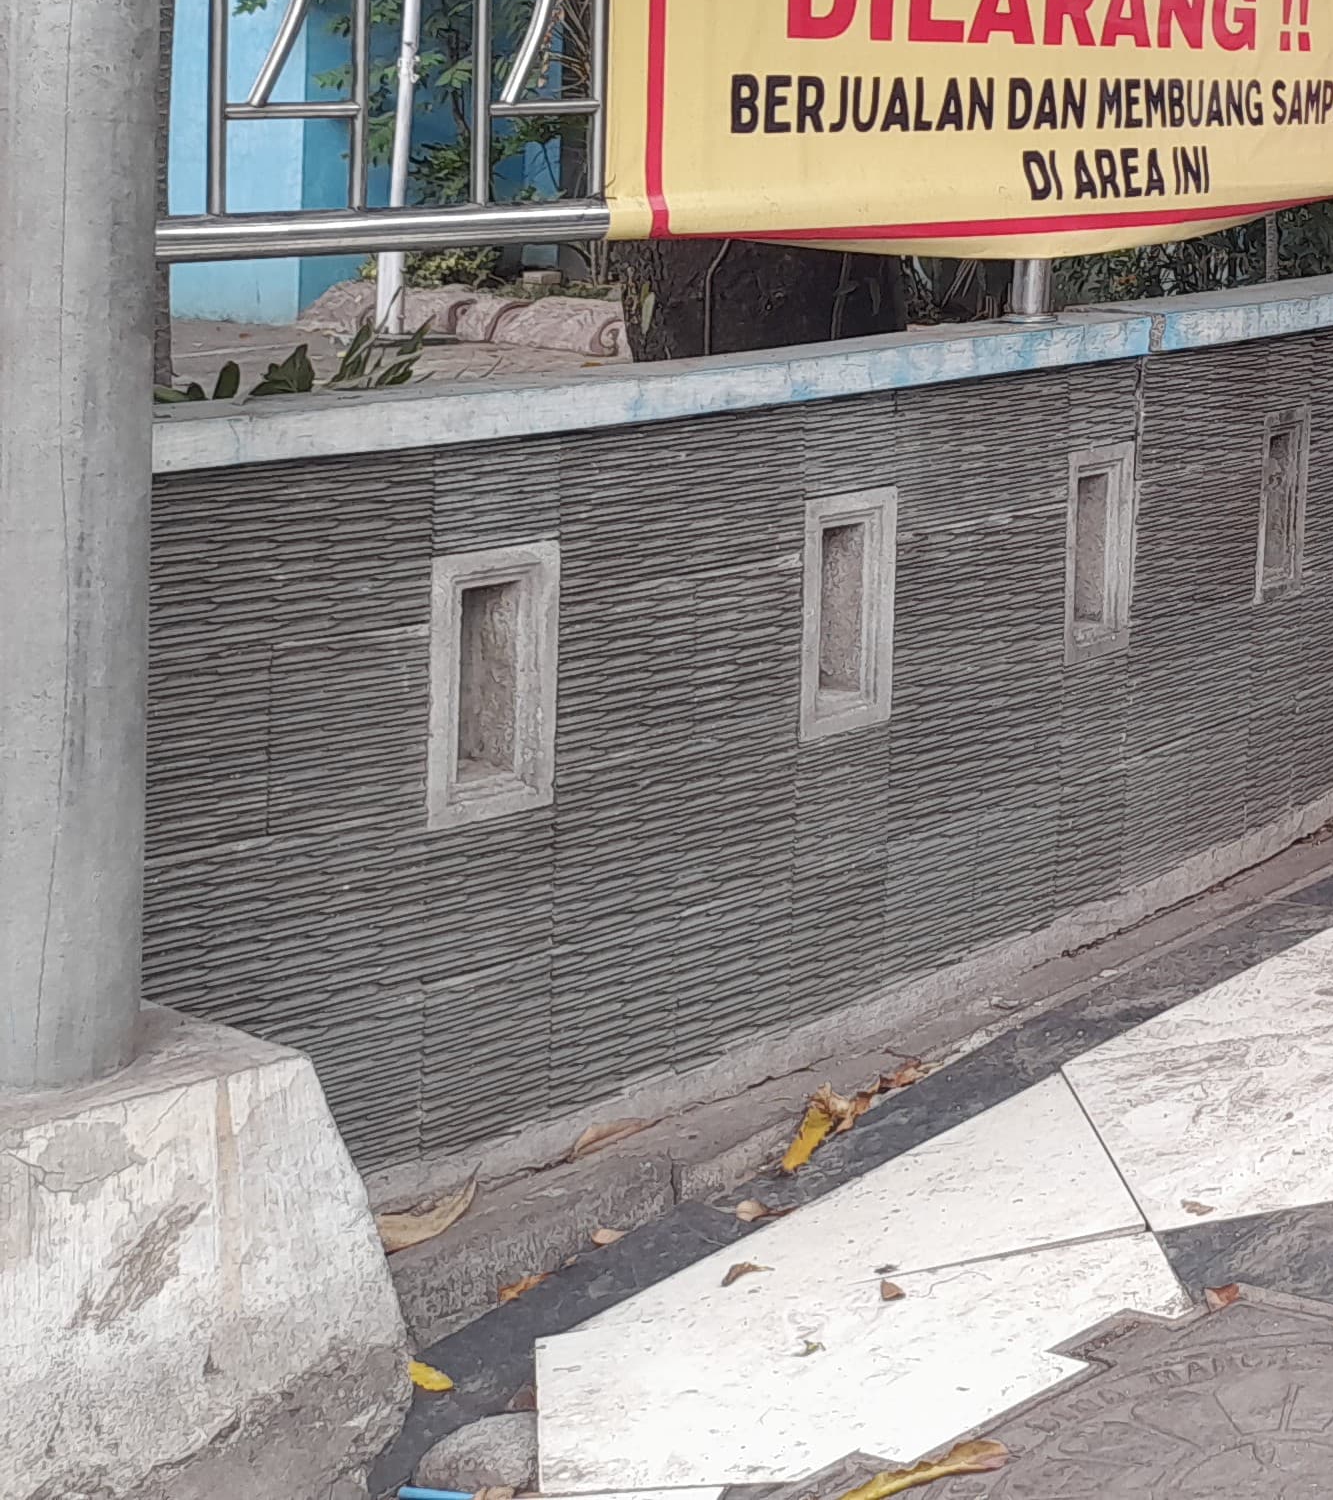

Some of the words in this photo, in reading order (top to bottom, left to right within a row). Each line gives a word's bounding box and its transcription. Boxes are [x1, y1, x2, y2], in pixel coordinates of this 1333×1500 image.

[730, 73, 994, 134] BERJUALAN
[1007, 77, 1087, 130] DAN
[1099, 78, 1264, 130] MEMBUANG
[1022, 149, 1063, 201] DI
[1074, 147, 1165, 200] AREA
[1173, 145, 1210, 197] INI
